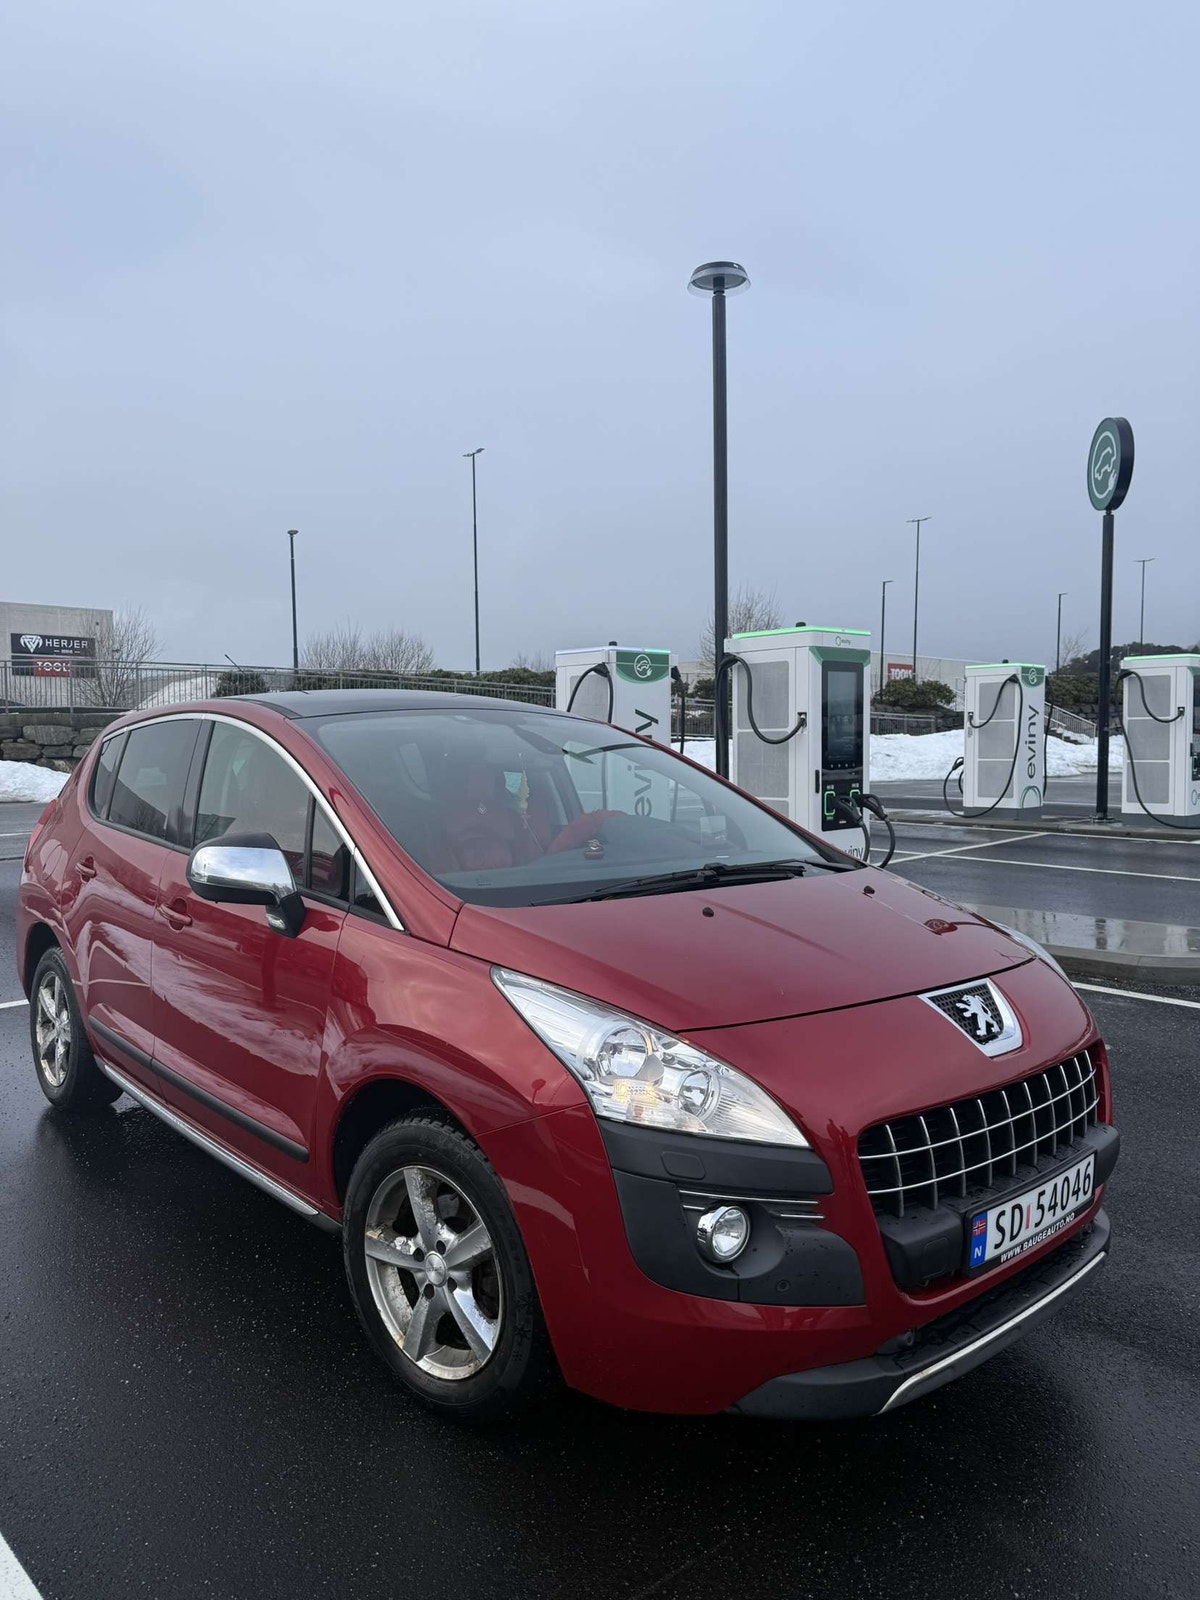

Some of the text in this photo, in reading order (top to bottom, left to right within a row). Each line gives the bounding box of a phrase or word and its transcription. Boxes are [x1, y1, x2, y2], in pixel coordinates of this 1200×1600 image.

[45, 638, 88, 649] HERJER
[1025, 704, 1040, 779] eviny
[993, 1160, 1092, 1250] SD 54046
[973, 1245, 983, 1259] N
[1000, 1212, 1075, 1263] WWW.BAUGEAUTO.NO
